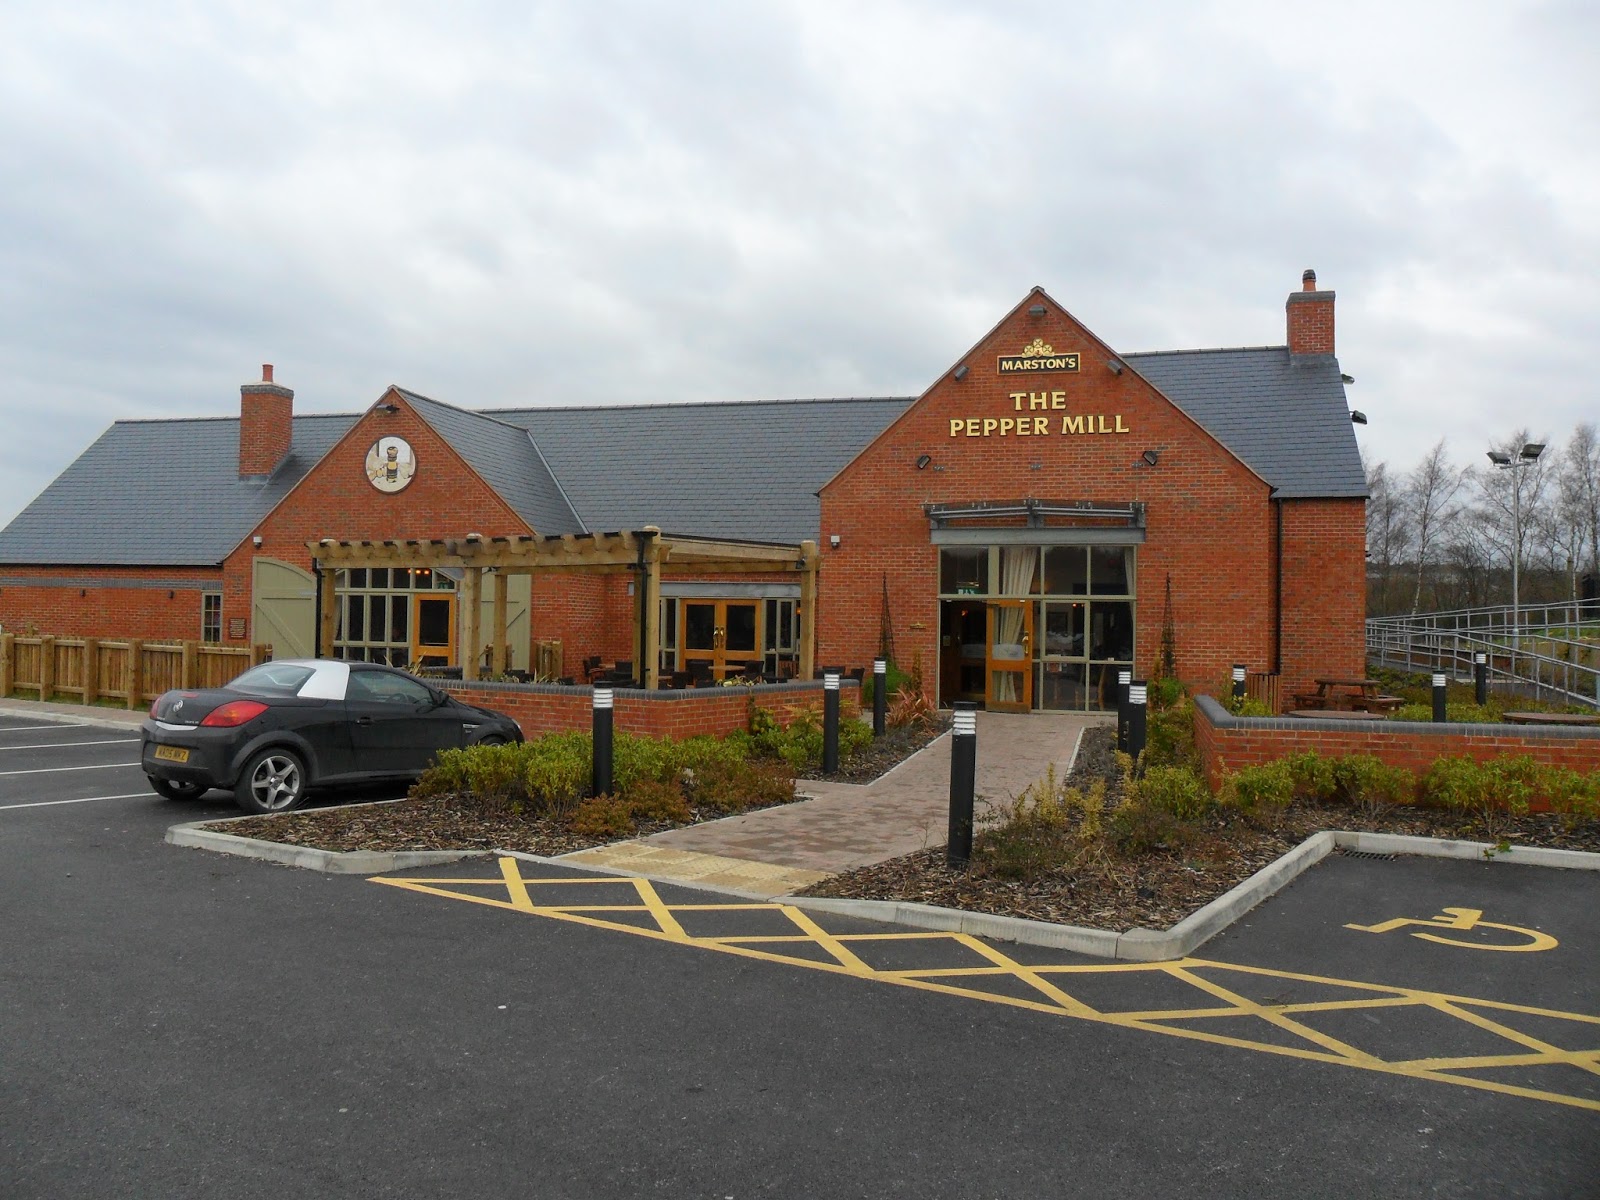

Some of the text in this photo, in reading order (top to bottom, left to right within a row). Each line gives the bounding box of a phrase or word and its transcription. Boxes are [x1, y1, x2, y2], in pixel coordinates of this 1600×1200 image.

[1001, 358, 1076, 371] MARSTON'S
[1009, 391, 1067, 411] THE
[949, 415, 1130, 437] PEPPER MILL
